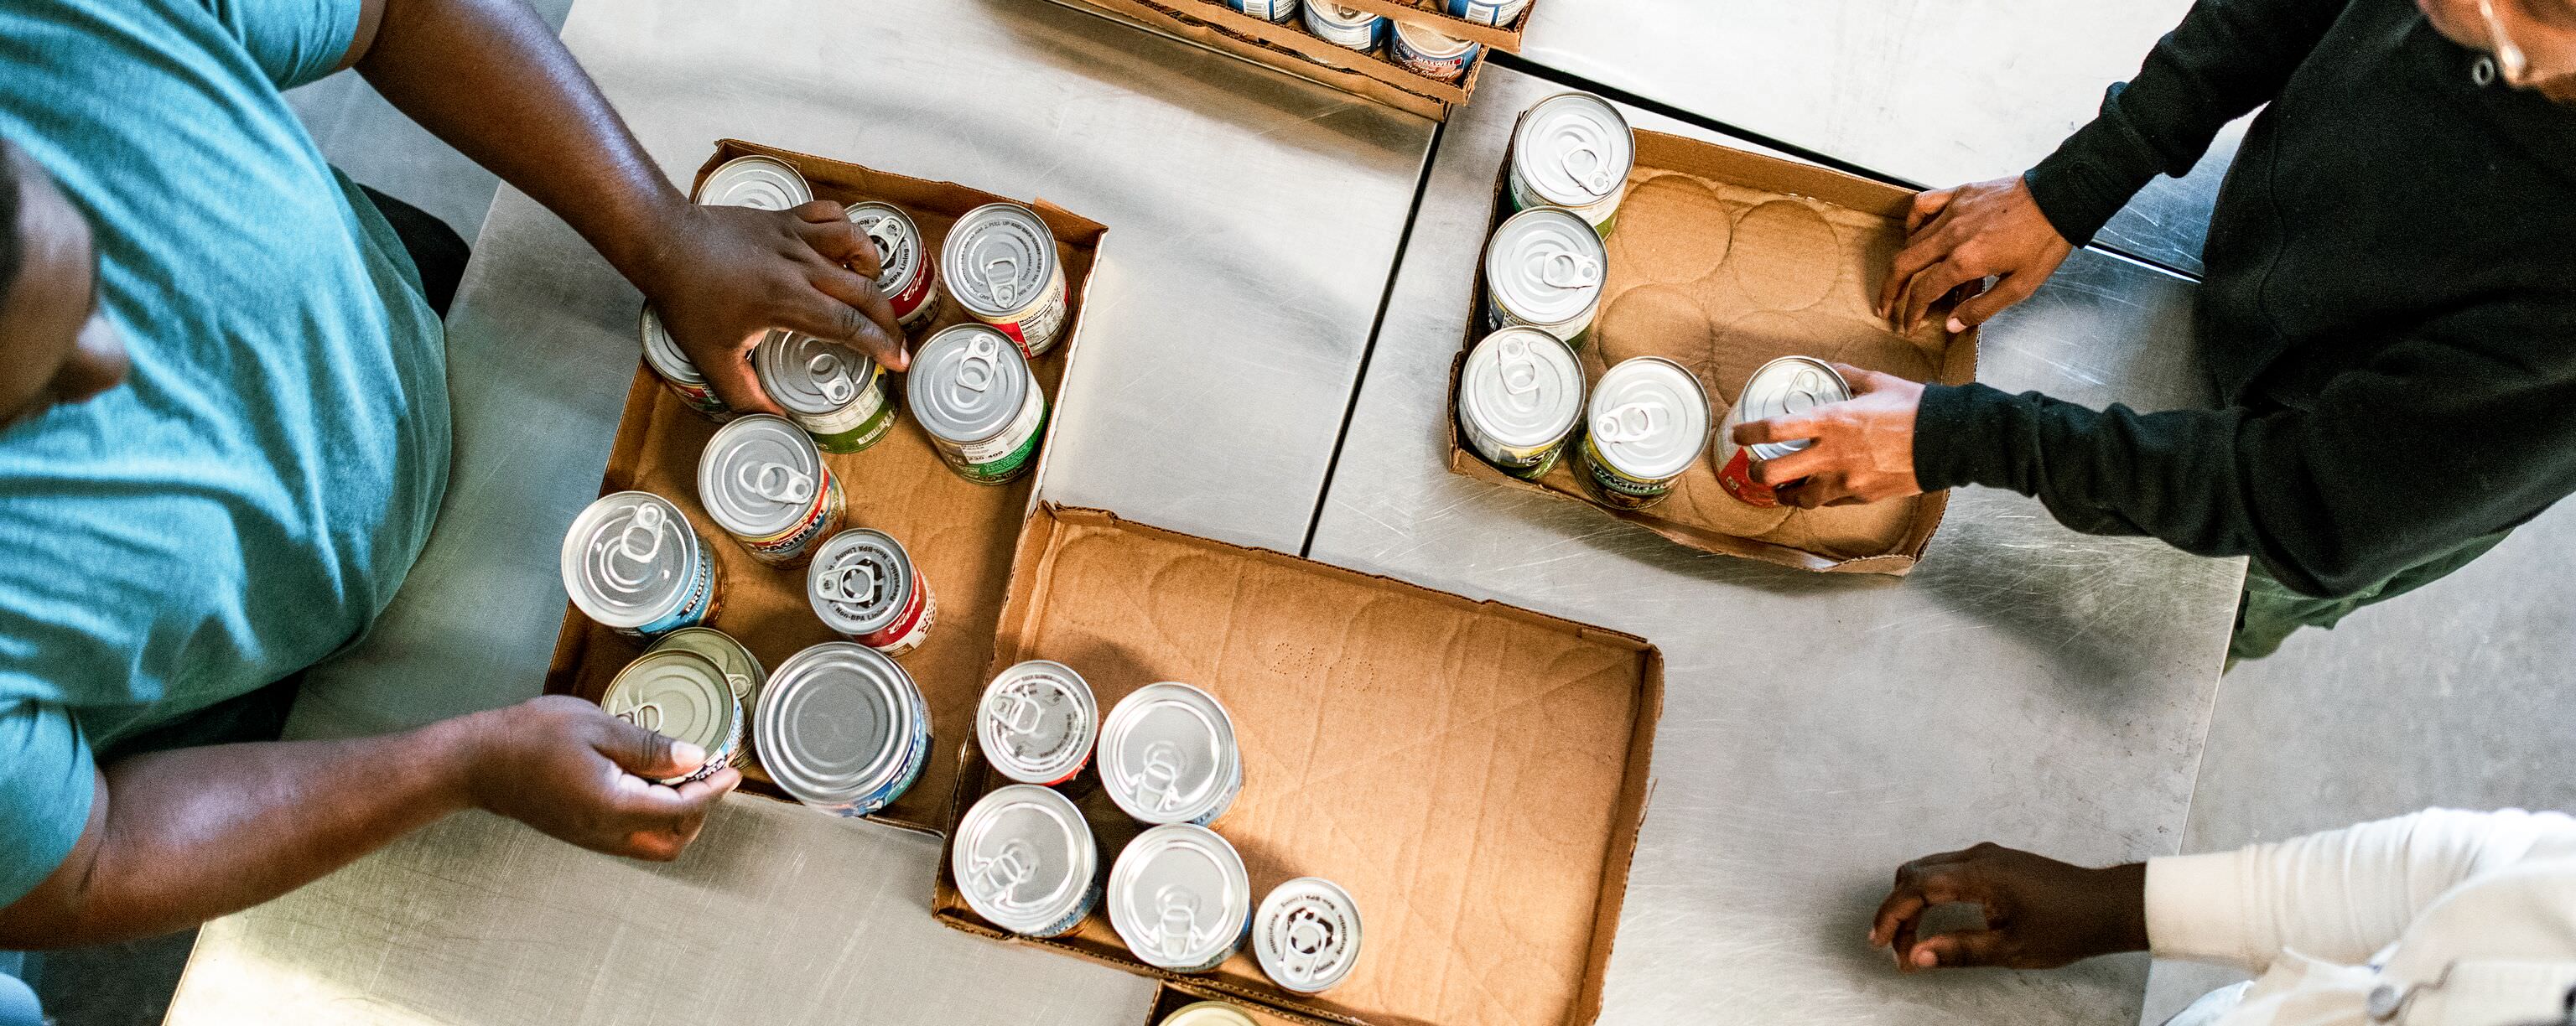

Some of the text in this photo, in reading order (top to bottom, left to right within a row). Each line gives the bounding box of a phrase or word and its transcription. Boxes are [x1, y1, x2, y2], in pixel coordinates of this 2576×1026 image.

[1415, 57, 1455, 66] MAXWELL
[901, 248, 910, 271] Lining
[987, 450, 1005, 459] 400
[834, 545, 890, 562] Non-BPA Lining
[835, 606, 865, 622] Non-BPA
